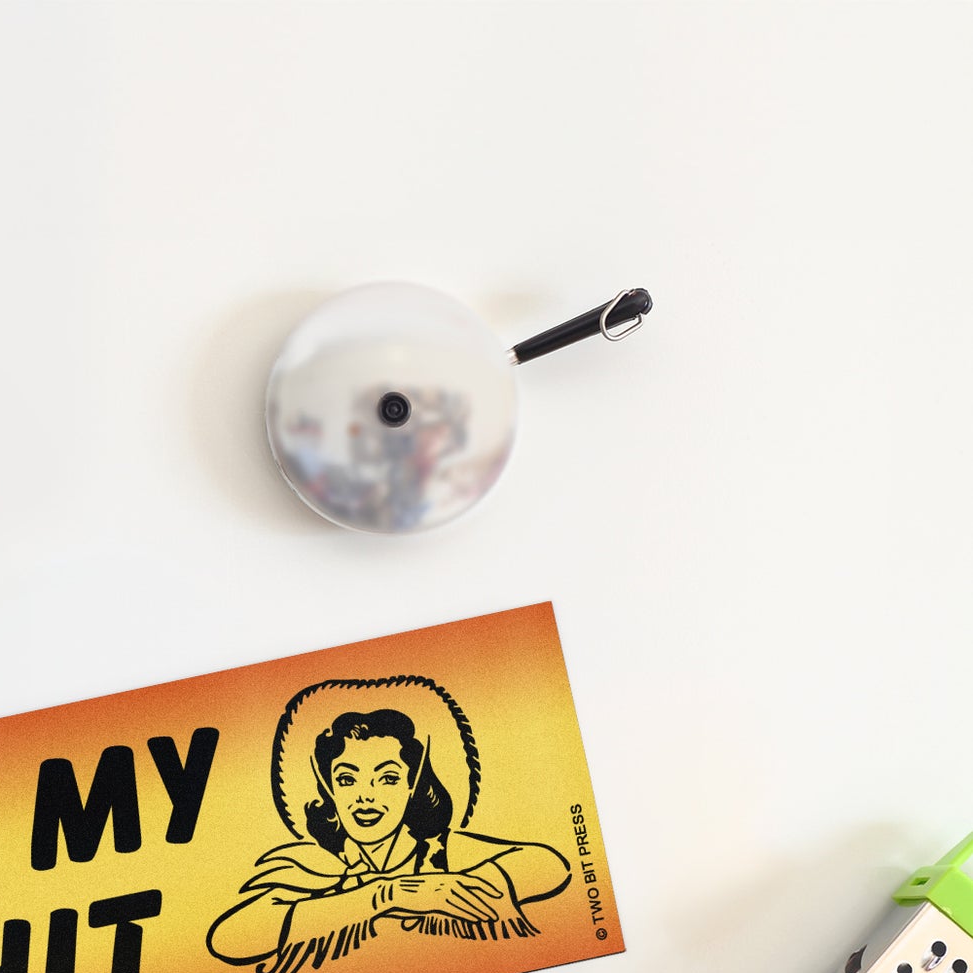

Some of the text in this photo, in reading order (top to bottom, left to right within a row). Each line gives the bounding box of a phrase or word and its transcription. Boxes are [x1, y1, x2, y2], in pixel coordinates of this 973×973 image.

[30, 727, 220, 872] MY
[570, 803, 591, 857] PRESS
[581, 861, 597, 884] BIT
[588, 887, 605, 926] TWO
